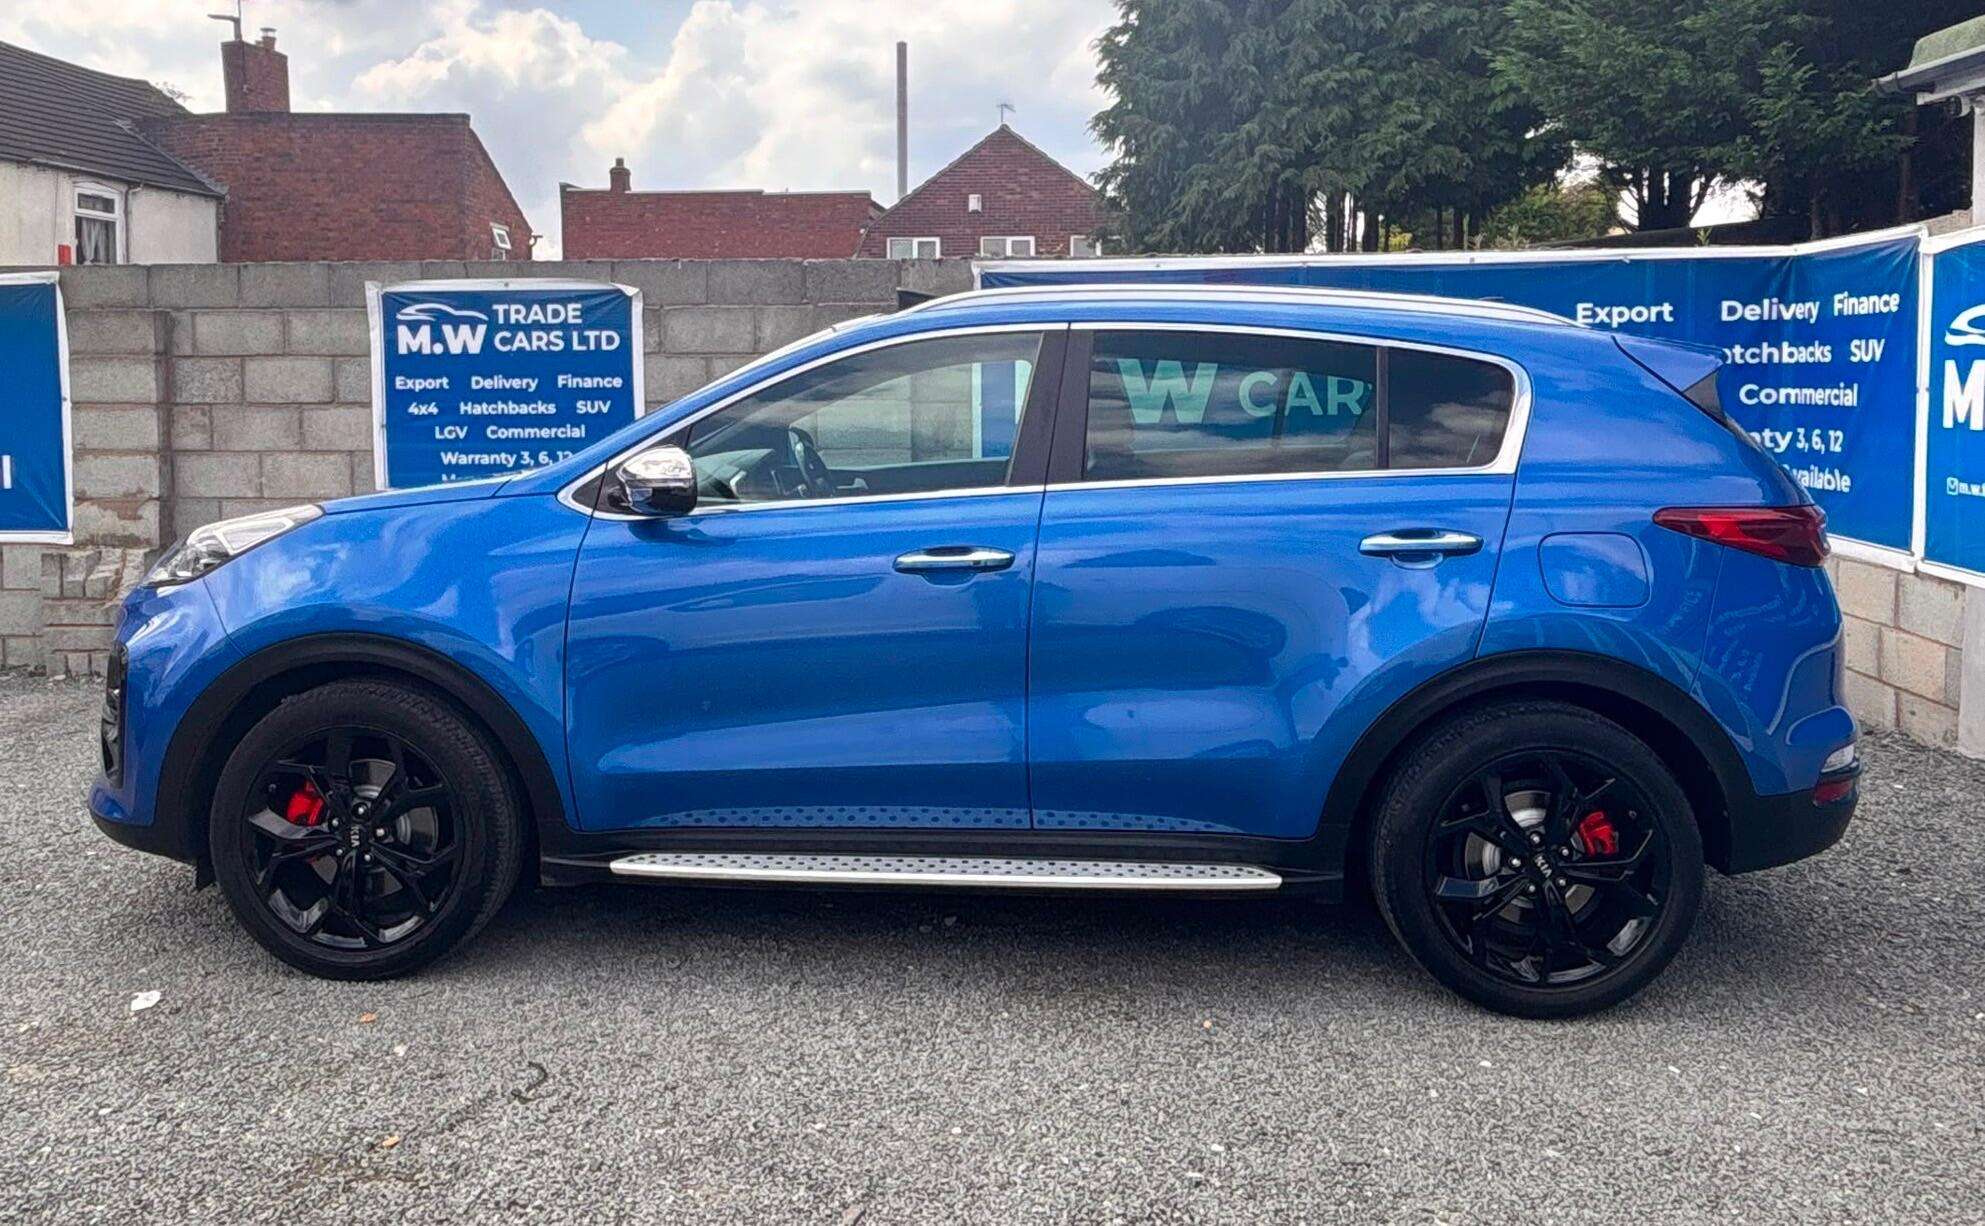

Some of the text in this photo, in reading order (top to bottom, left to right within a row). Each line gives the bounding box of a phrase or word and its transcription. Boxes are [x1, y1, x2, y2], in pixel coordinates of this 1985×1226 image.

[492, 303, 583, 324] TRADE
[1576, 291, 1900, 328] Export Delivery Finance
[397, 324, 488, 355] M.W
[493, 330, 621, 352] CARS LTD
[1850, 338, 1885, 363] SUV
[395, 374, 623, 392] Export Delivery Finance
[1238, 370, 1373, 417] CAR
[1739, 381, 1858, 407] Commercial
[407, 400, 611, 416] 4x4 Hatchbacks SUV
[435, 424, 586, 440] LGV Commercial
[1796, 427, 1809, 453] 3,
[1811, 428, 1826, 455] 6,
[1828, 429, 1844, 453] 12
[440, 451, 517, 468] Warranty
[520, 450, 535, 466] 3,
[538, 450, 553, 466] 6,
[1782, 463, 1851, 493] vailable
